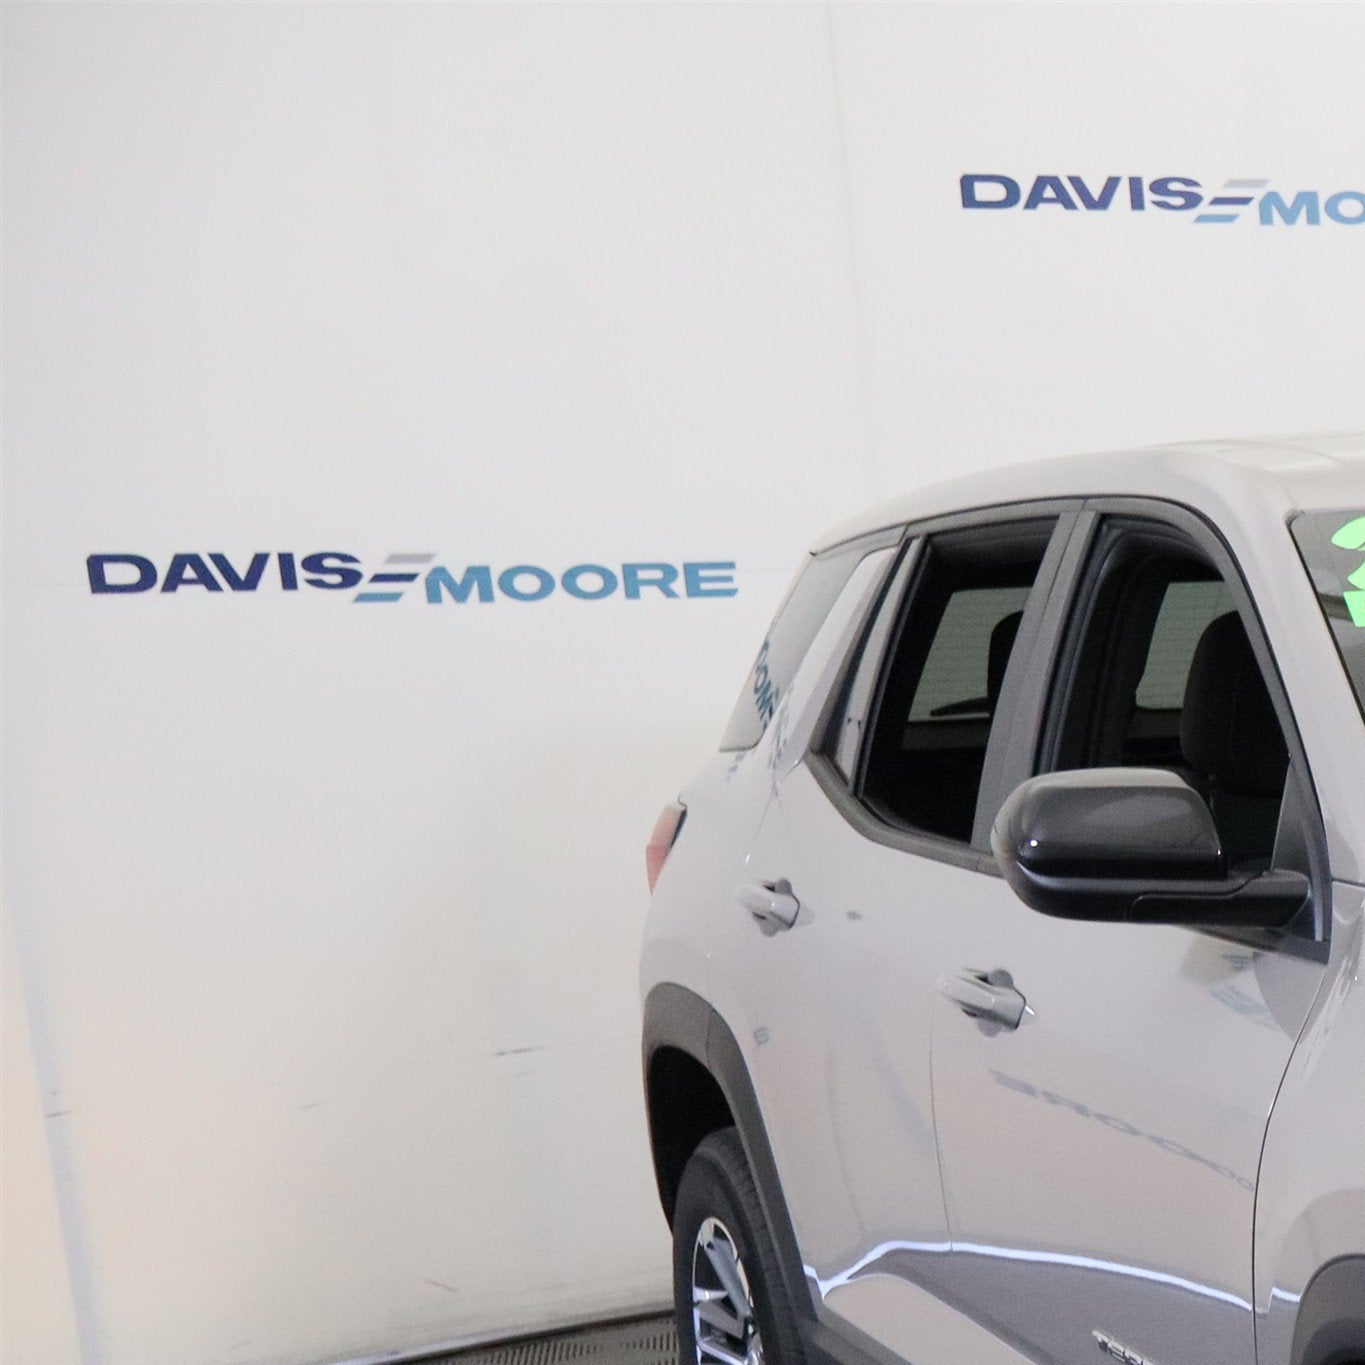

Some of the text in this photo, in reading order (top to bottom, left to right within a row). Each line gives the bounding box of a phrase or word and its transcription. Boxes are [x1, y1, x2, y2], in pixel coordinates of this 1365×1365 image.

[958, 172, 1205, 213] DAVIS
[85, 550, 740, 606] DAVIS MOORE
